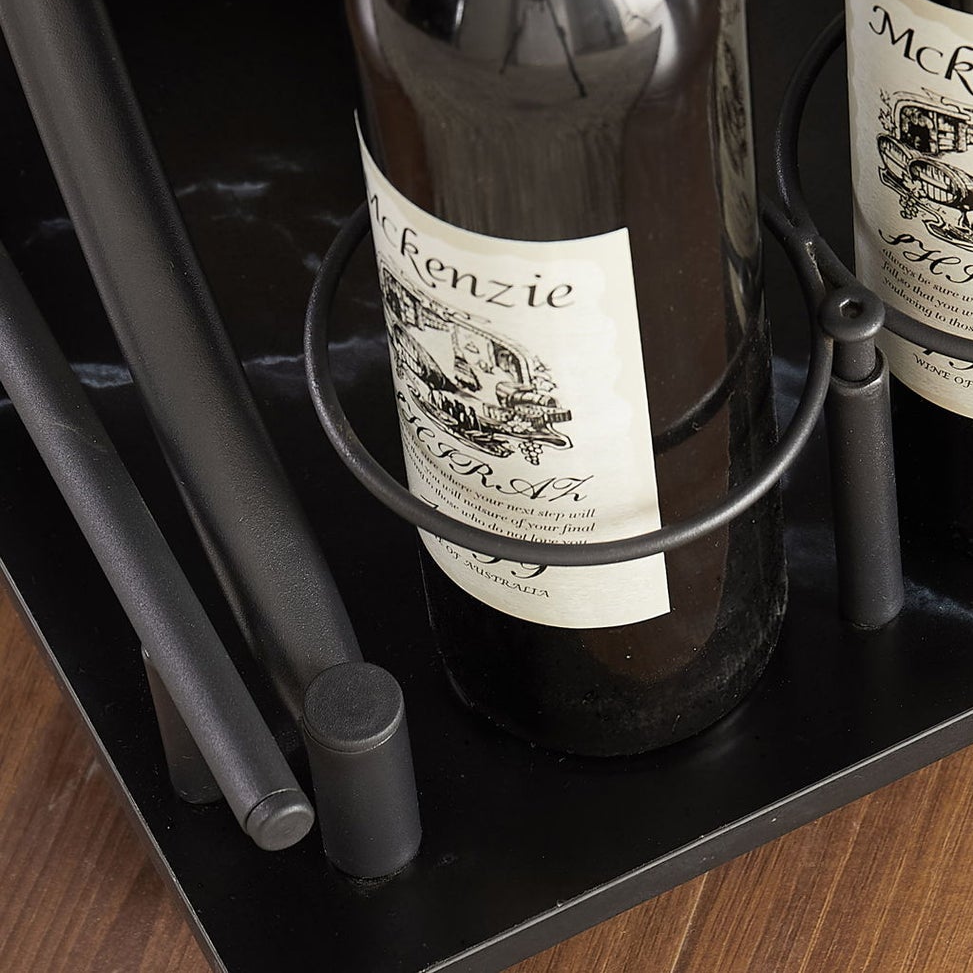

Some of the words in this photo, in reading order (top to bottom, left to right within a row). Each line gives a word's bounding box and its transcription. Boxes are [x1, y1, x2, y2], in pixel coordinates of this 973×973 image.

[912, 285, 935, 303] that
[934, 299, 960, 314] you
[917, 273, 931, 286] be
[932, 284, 960, 298] sure
[934, 312, 947, 322] to
[912, 352, 952, 381] WINE
[440, 470, 473, 493] where
[473, 491, 505, 507] your
[506, 504, 535, 515] next
[537, 510, 565, 521] step
[568, 508, 596, 519] will
[442, 484, 462, 500] will
[511, 518, 526, 529] of
[524, 522, 560, 532] your
[558, 521, 596, 536] final
[461, 509, 486, 527] who
[488, 522, 504, 533] do
[506, 530, 527, 541] not
[464, 560, 550, 599] AUSTRALIA
